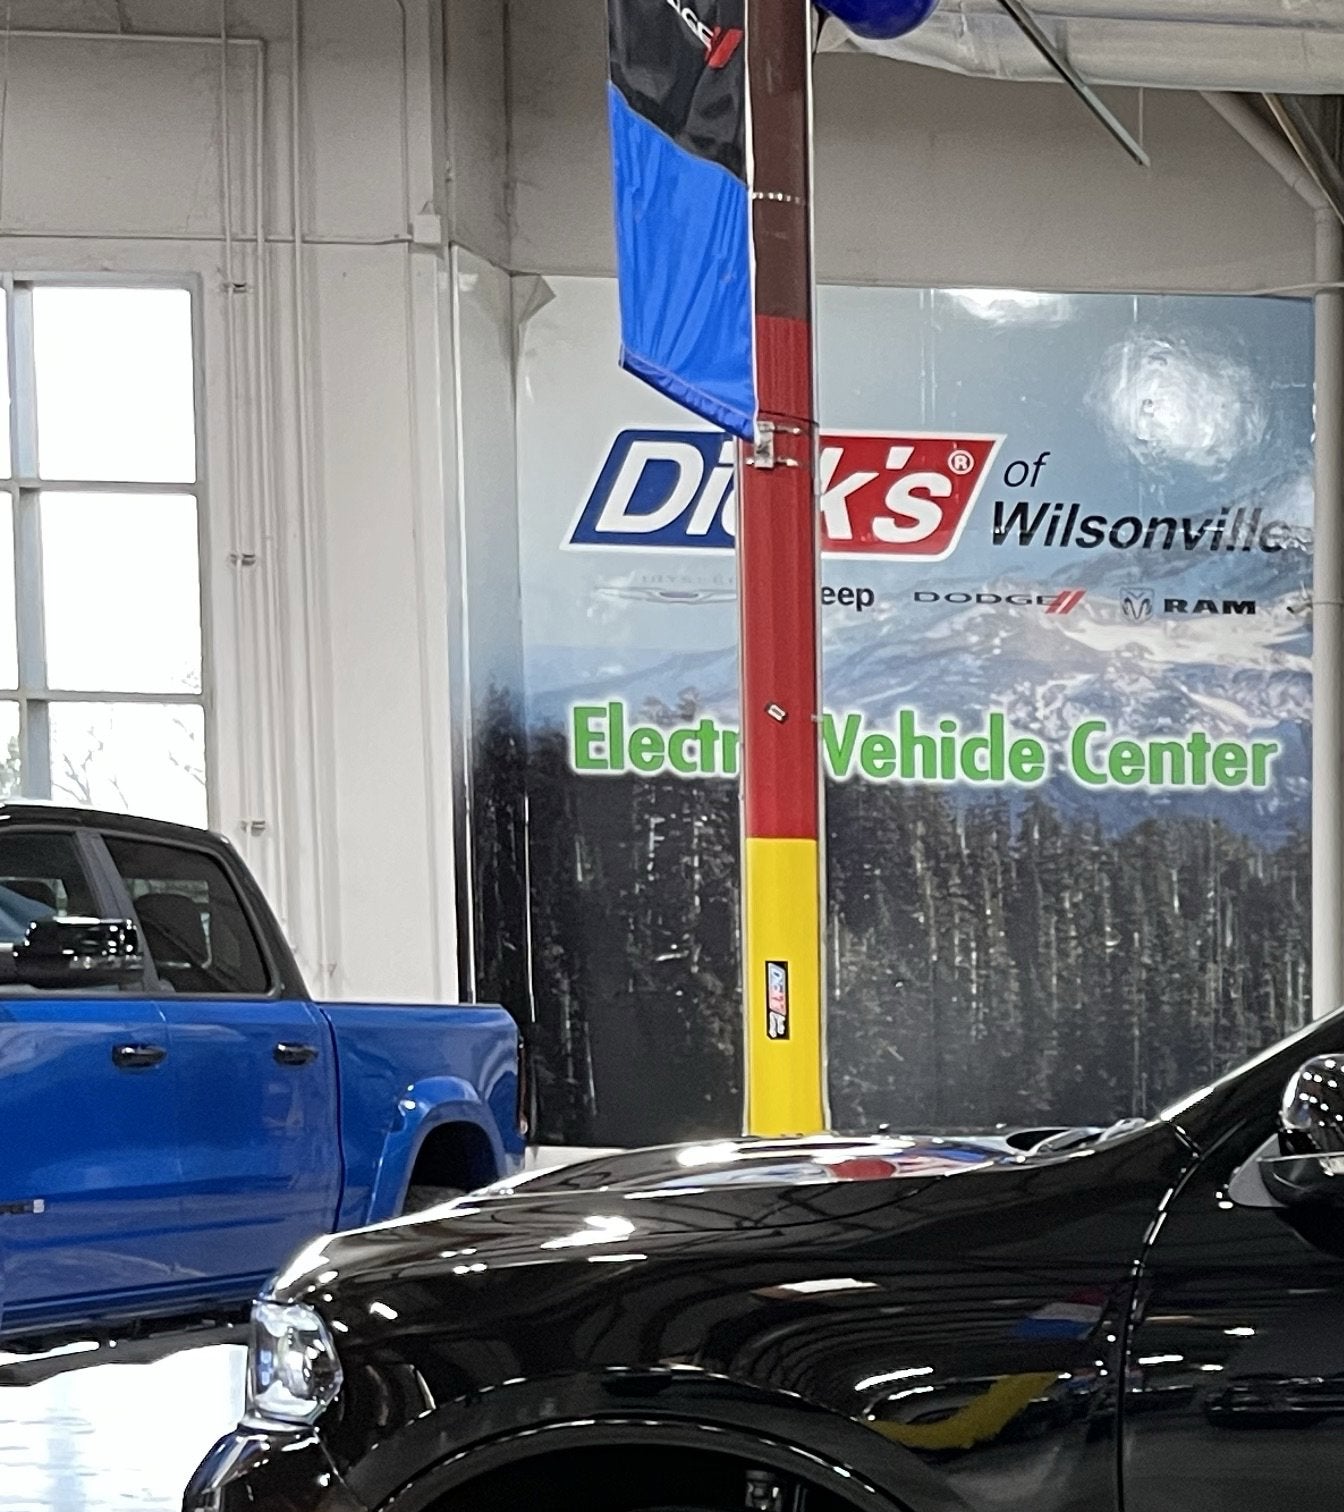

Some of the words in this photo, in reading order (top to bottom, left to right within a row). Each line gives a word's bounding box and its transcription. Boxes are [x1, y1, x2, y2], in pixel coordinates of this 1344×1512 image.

[1003, 451, 1051, 487] of
[821, 585, 875, 611] eep
[914, 591, 1056, 606] DODGE
[1164, 598, 1256, 614] RAM
[823, 709, 1046, 782] Vehicle
[1071, 720, 1278, 787] Center
